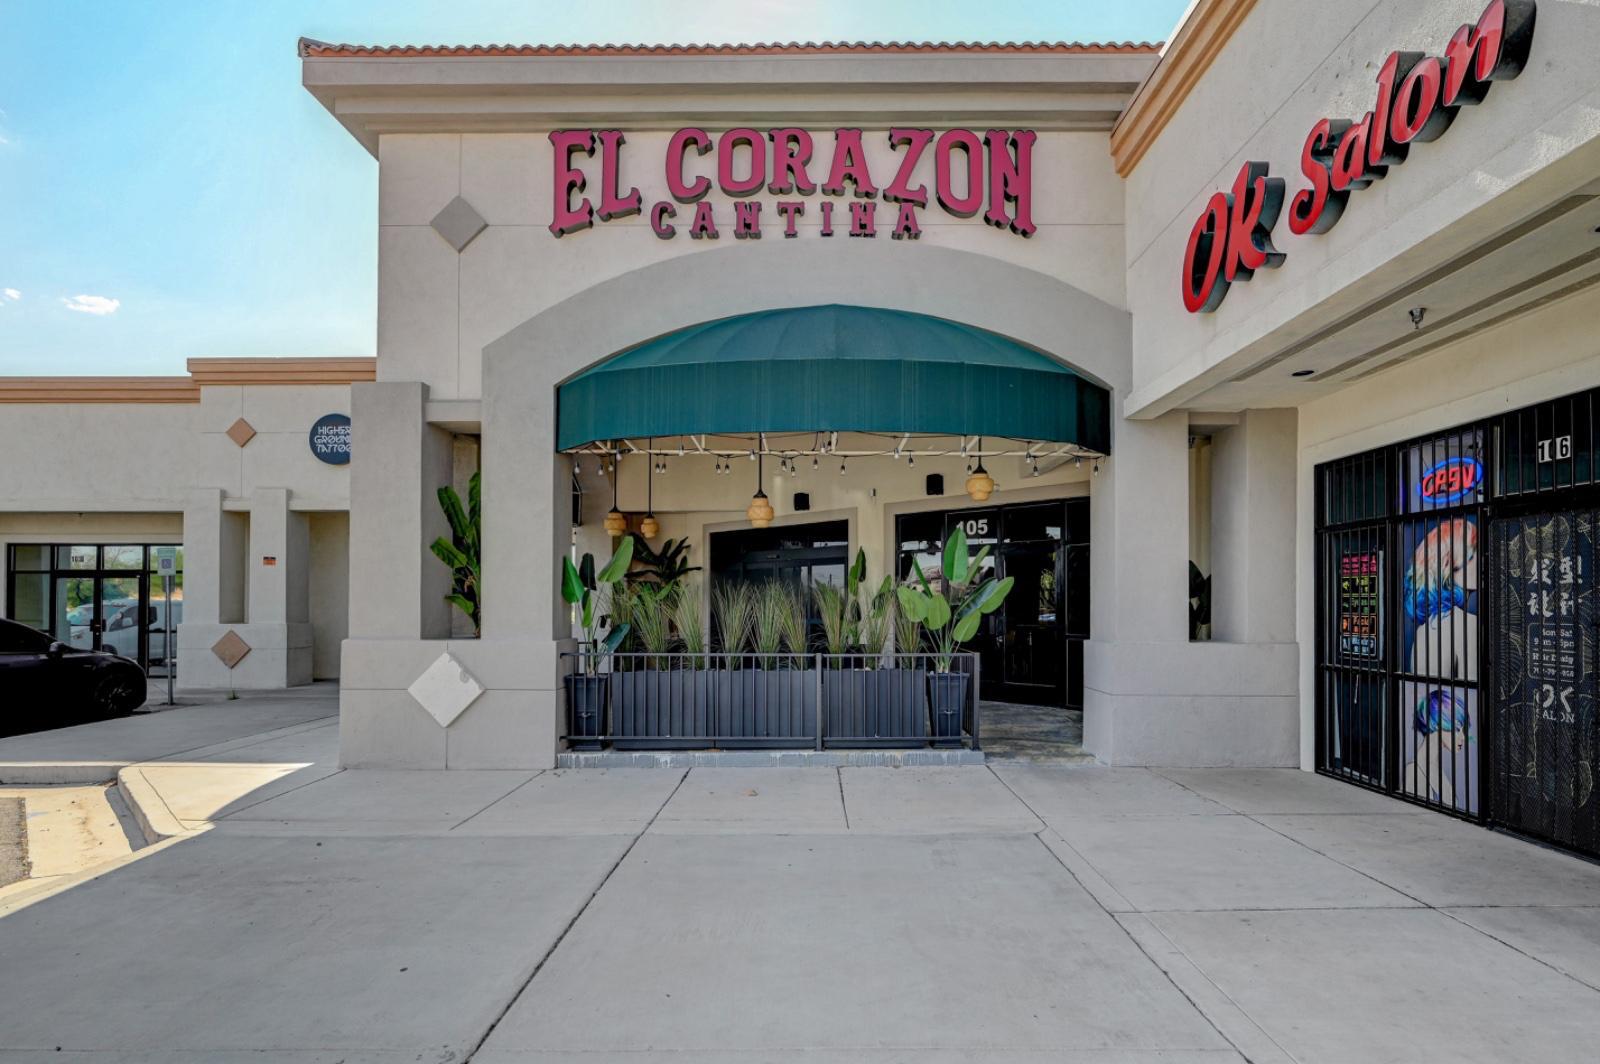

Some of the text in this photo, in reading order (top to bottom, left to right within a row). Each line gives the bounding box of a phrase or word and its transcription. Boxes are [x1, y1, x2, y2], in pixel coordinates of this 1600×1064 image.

[549, 127, 1038, 239] EL CORAZON
[1182, 0, 1535, 313] OK Salon
[650, 201, 922, 240] CANTINA
